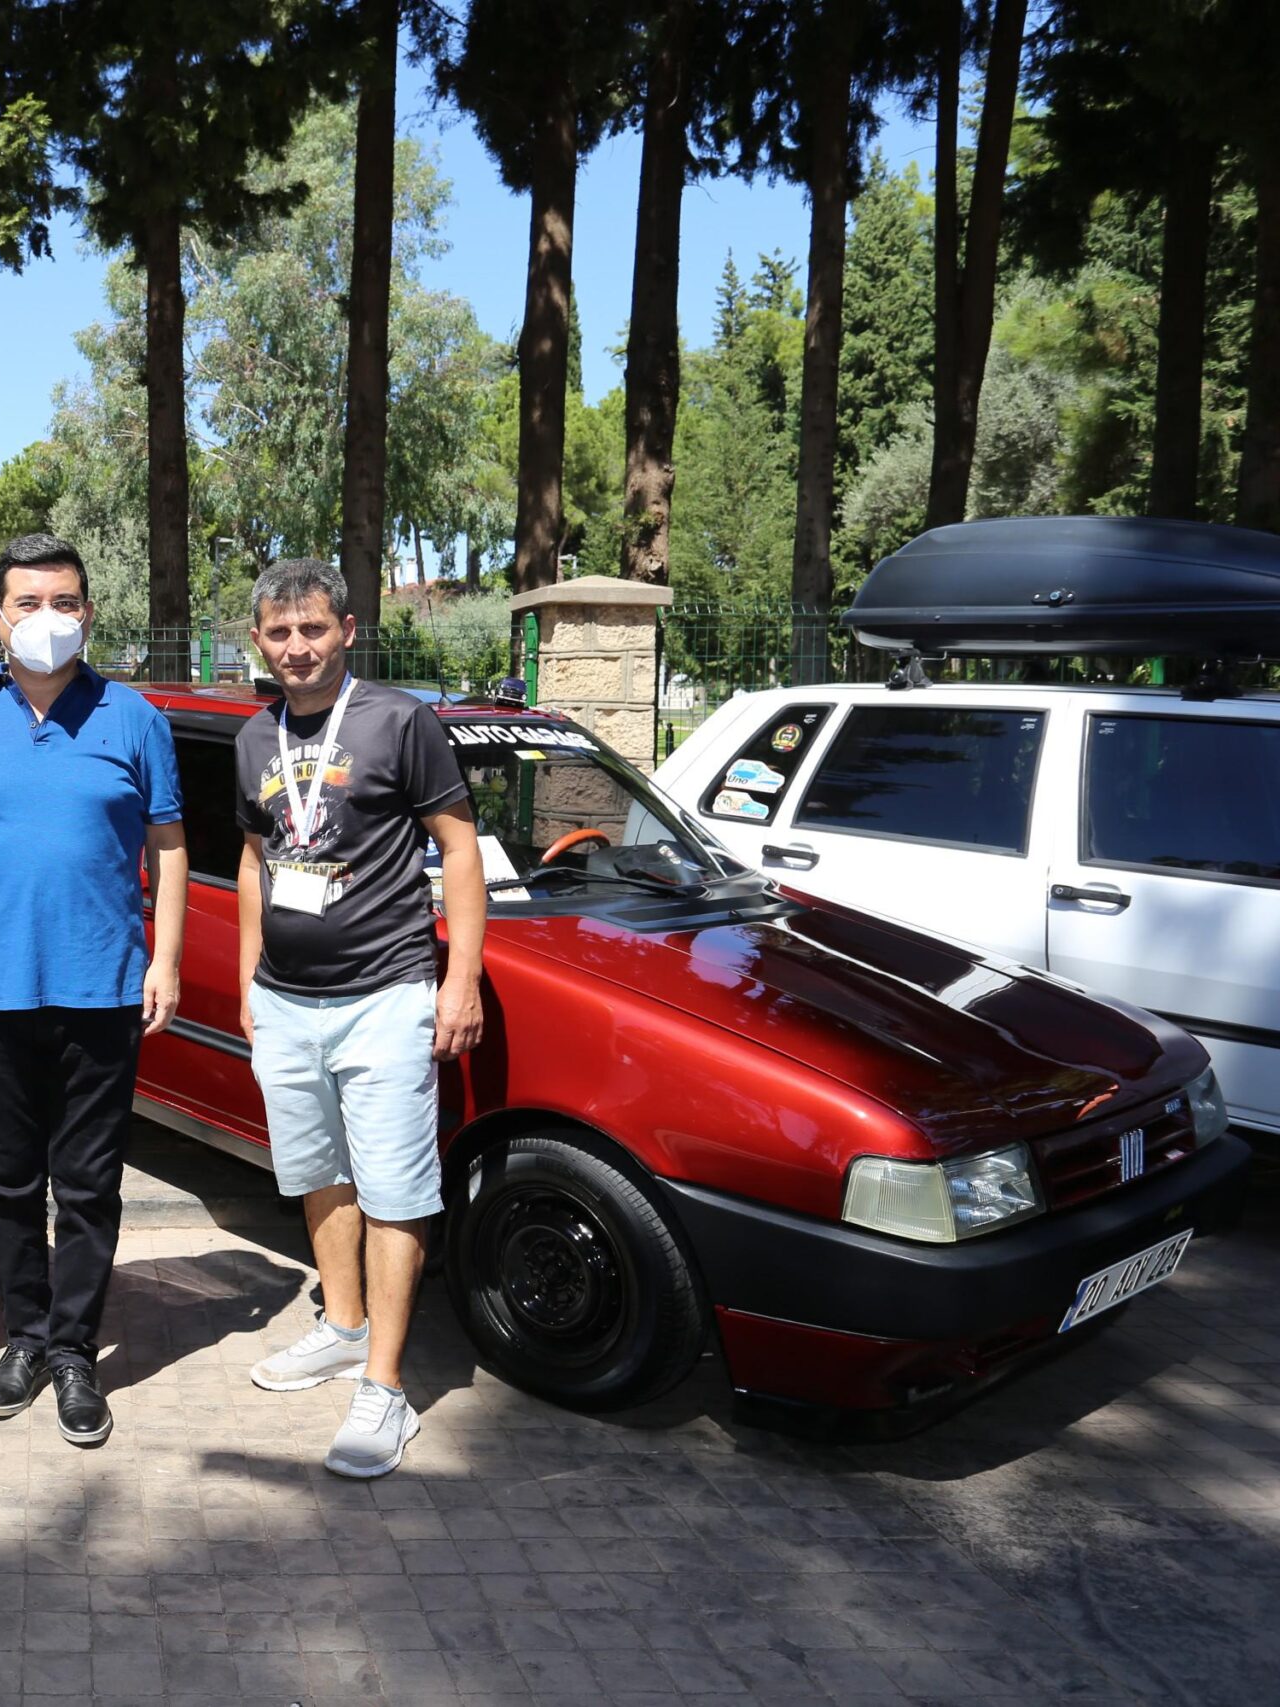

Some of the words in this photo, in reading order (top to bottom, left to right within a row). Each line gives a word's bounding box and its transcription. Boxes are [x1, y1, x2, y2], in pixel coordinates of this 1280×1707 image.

[450, 724, 518, 745] AUTO
[727, 774, 749, 785] Uno
[1075, 1274, 1109, 1319] 20
[1146, 1236, 1189, 1283] 225
